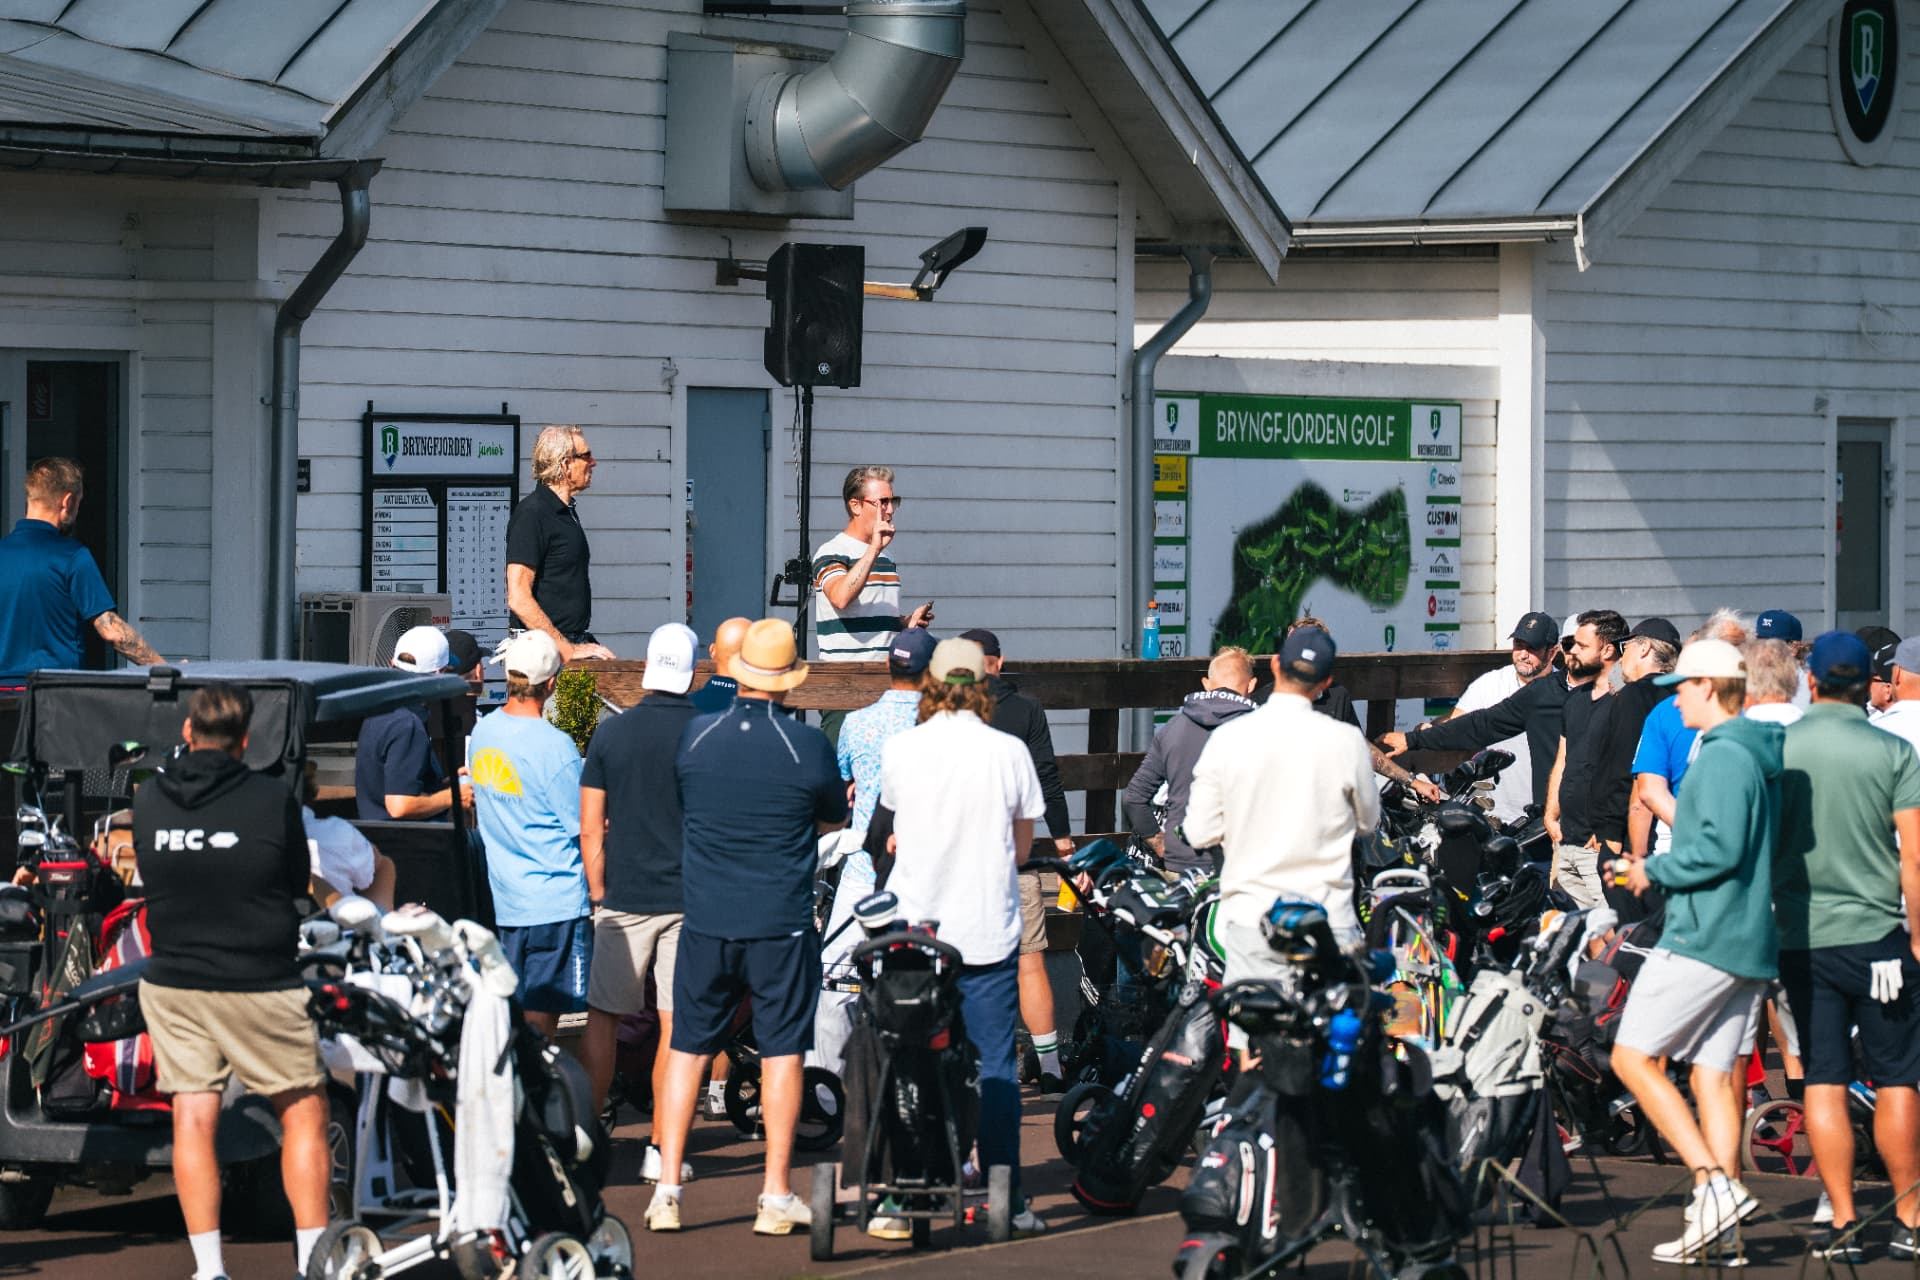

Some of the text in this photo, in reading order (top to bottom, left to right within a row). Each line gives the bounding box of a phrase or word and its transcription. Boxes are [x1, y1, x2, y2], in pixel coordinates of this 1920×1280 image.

[1216, 409, 1396, 447] BRYNGFJORDEN GOLF
[401, 436, 473, 457] BRYNGFJORDEN
[154, 828, 205, 852] PEC
